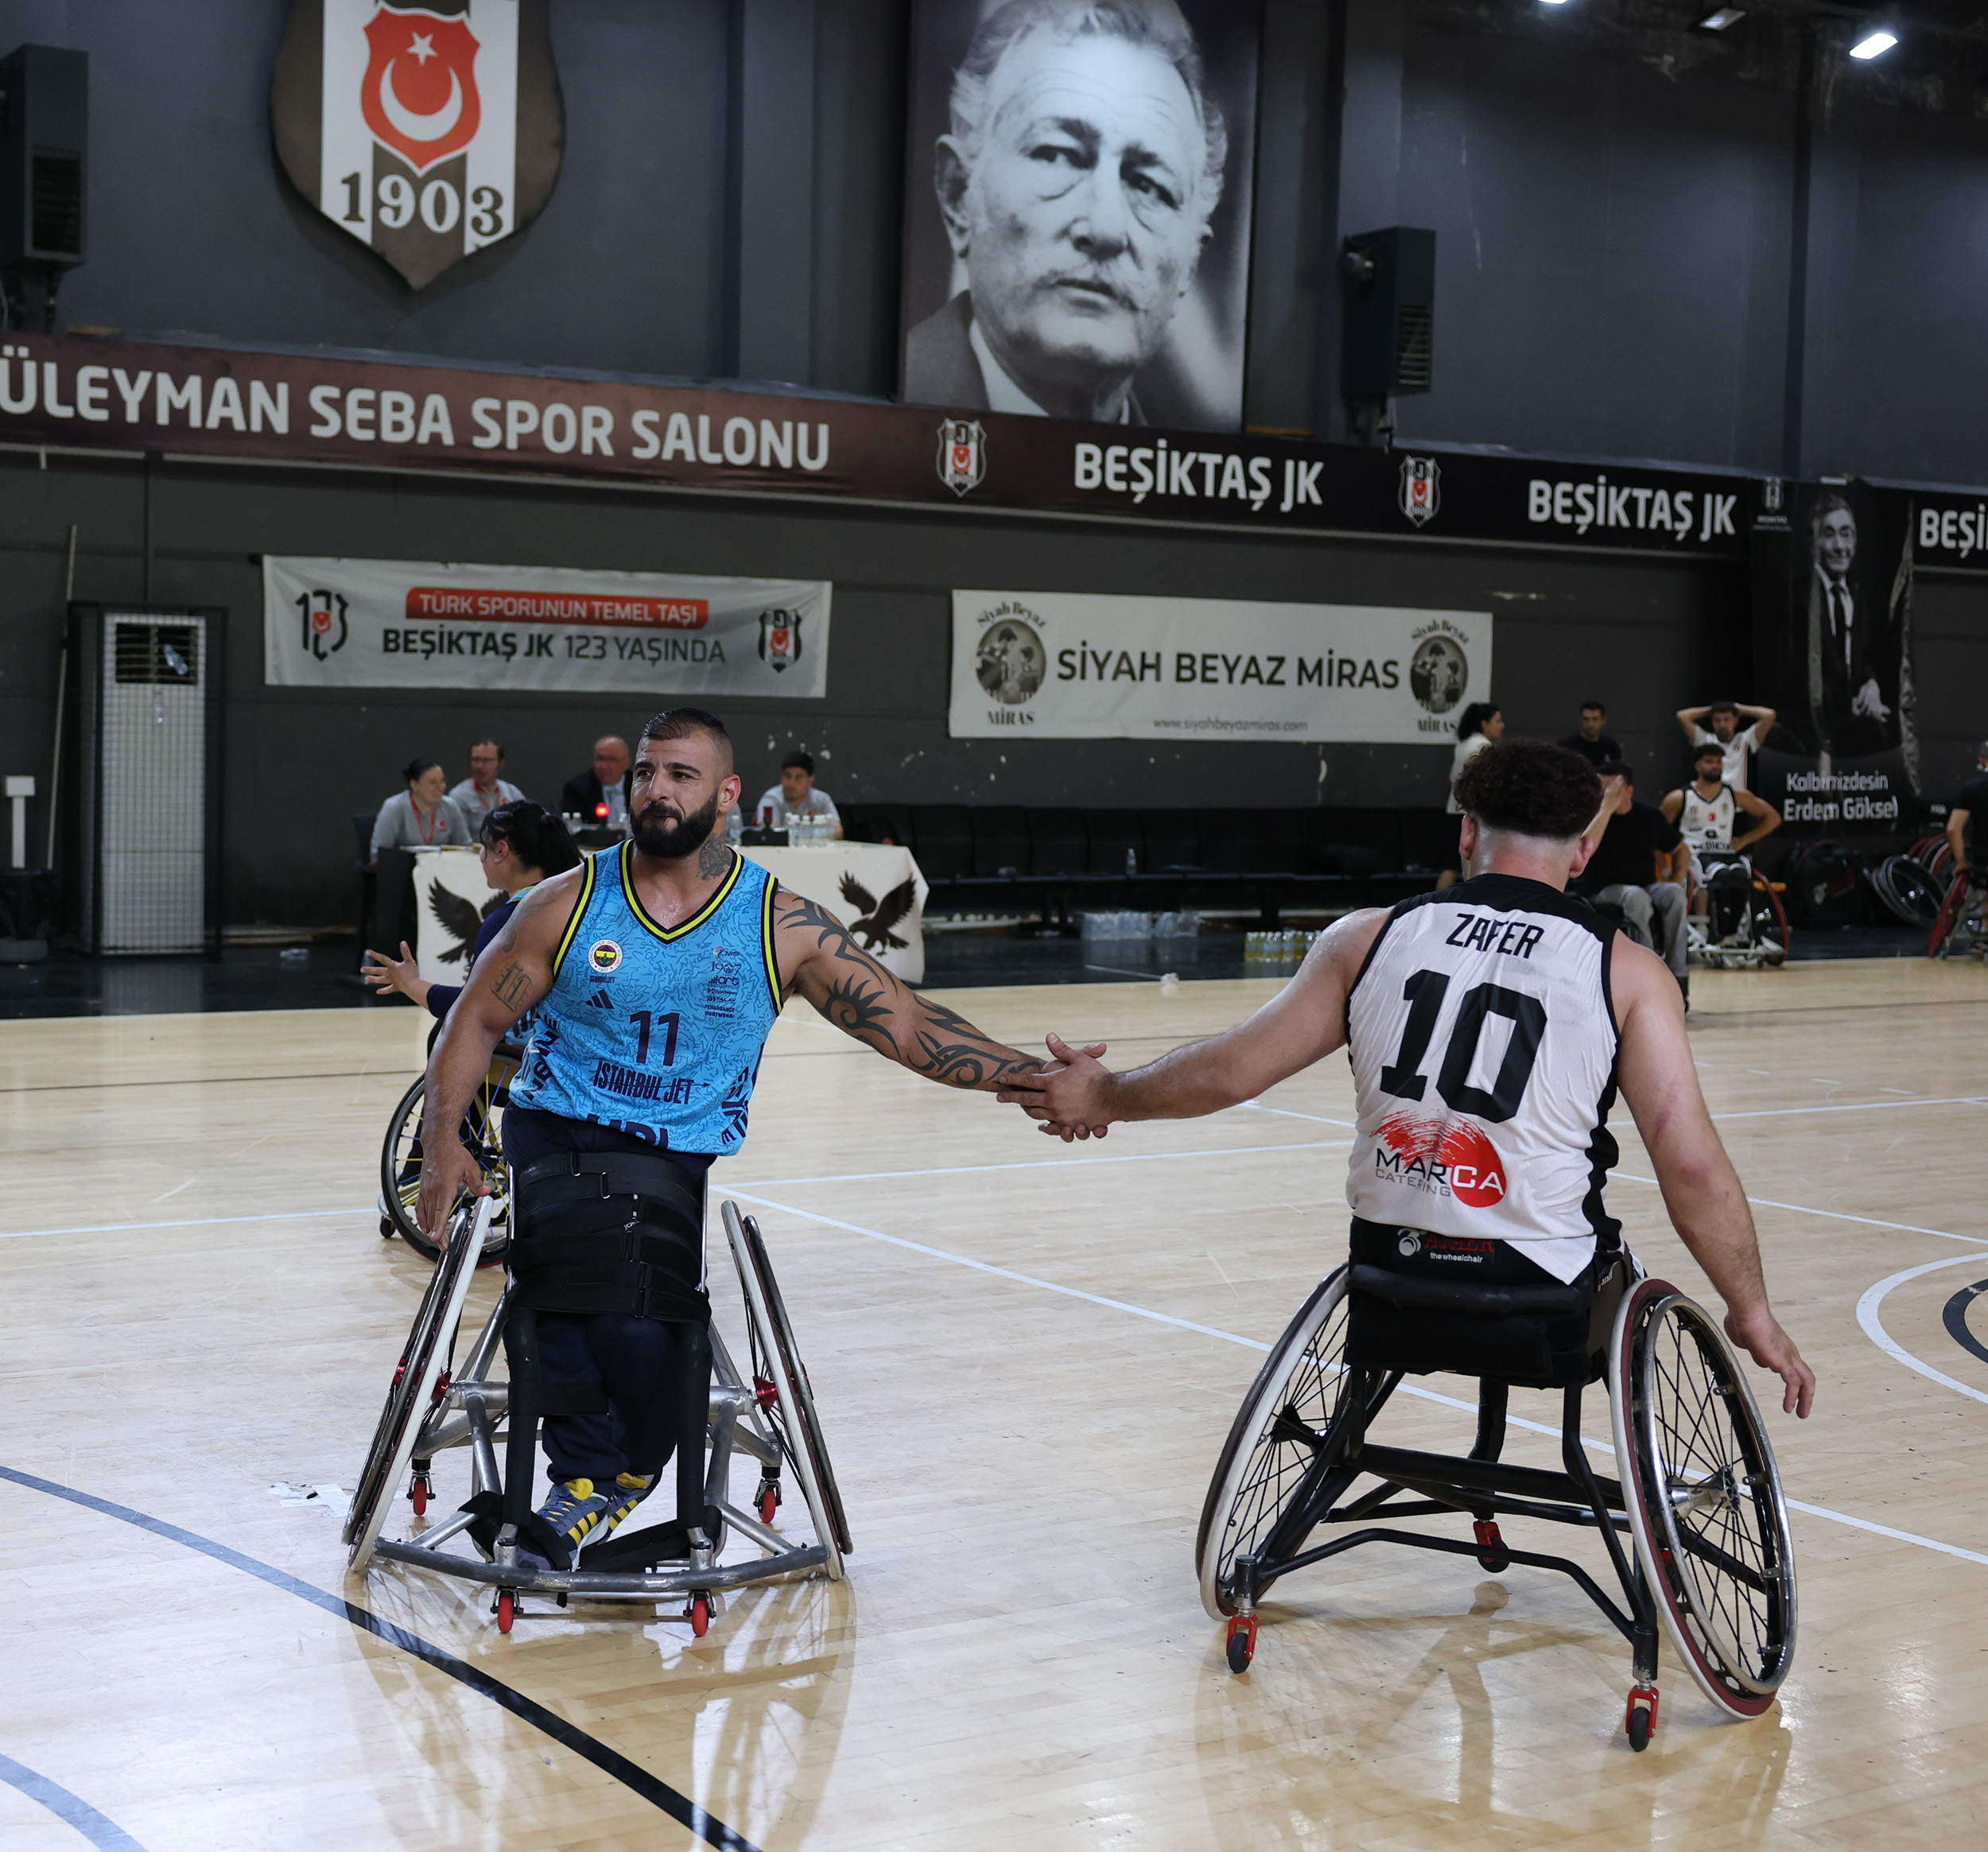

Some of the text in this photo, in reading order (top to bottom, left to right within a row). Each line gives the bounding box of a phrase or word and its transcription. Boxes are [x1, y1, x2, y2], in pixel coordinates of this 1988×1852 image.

[341, 172, 503, 237] 1903
[309, 385, 455, 446] SEBA
[471, 397, 615, 456] SPOR
[631, 409, 829, 471] SALONU
[1074, 438, 1325, 512] BEŞİKTAŞ JK
[1528, 475, 1737, 542] BEŞİKTAŞ JK
[1919, 503, 1988, 558] BEŞİ
[419, 591, 697, 627] TÜRK SPORUNUN TEMEL TAŞI
[382, 623, 726, 667] BEŞİKTAŞ JK 123 YAŞINDA
[1057, 639, 1400, 689] SİYAH BEYAZ MİRAS
[1784, 795, 1899, 821] Erdem Göksel
[1445, 912, 1545, 959] ZAFER
[629, 1011, 681, 1066] 11
[1380, 969, 1548, 1124] 10
[1376, 1148, 1505, 1196] MARCA
[1376, 1168, 1452, 1198] CATERING
